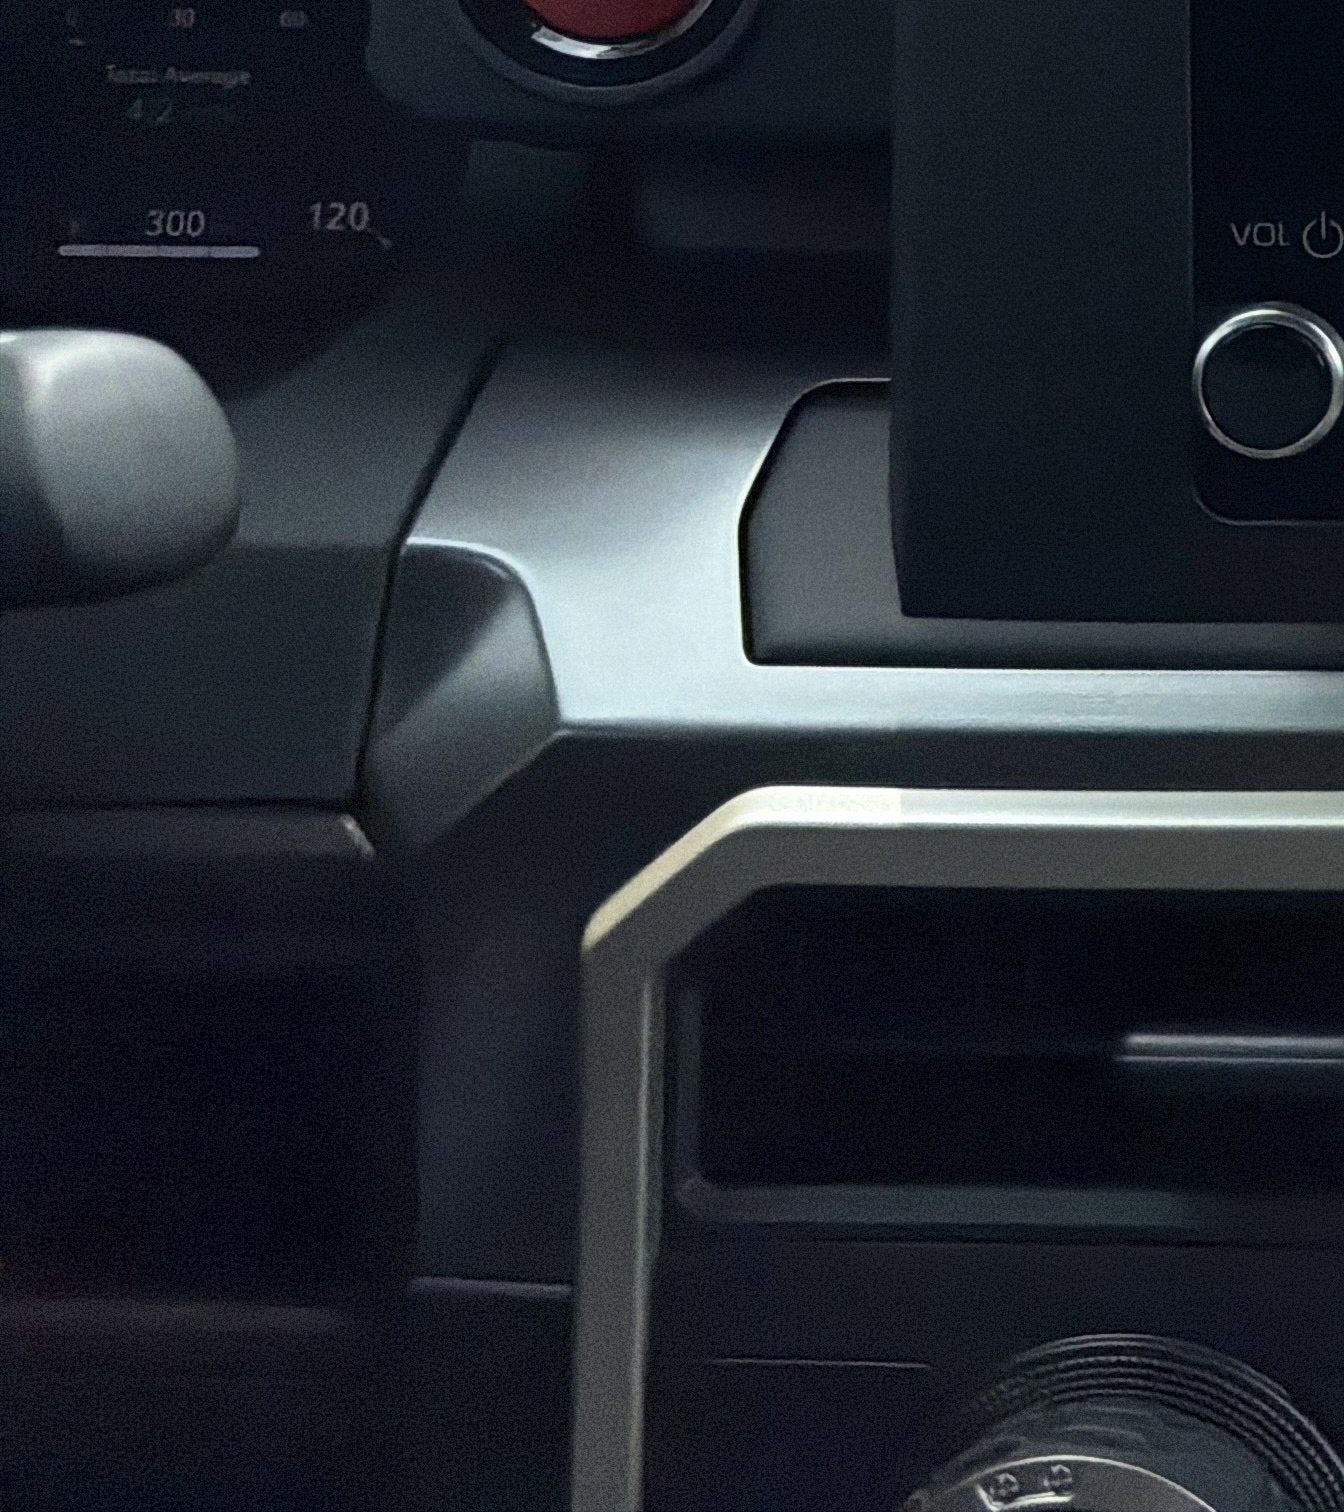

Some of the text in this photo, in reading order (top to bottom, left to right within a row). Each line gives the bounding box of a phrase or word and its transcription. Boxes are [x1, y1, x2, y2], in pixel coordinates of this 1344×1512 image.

[146, 210, 205, 237] 300
[308, 202, 370, 232] 120
[1231, 222, 1290, 247] VOL
